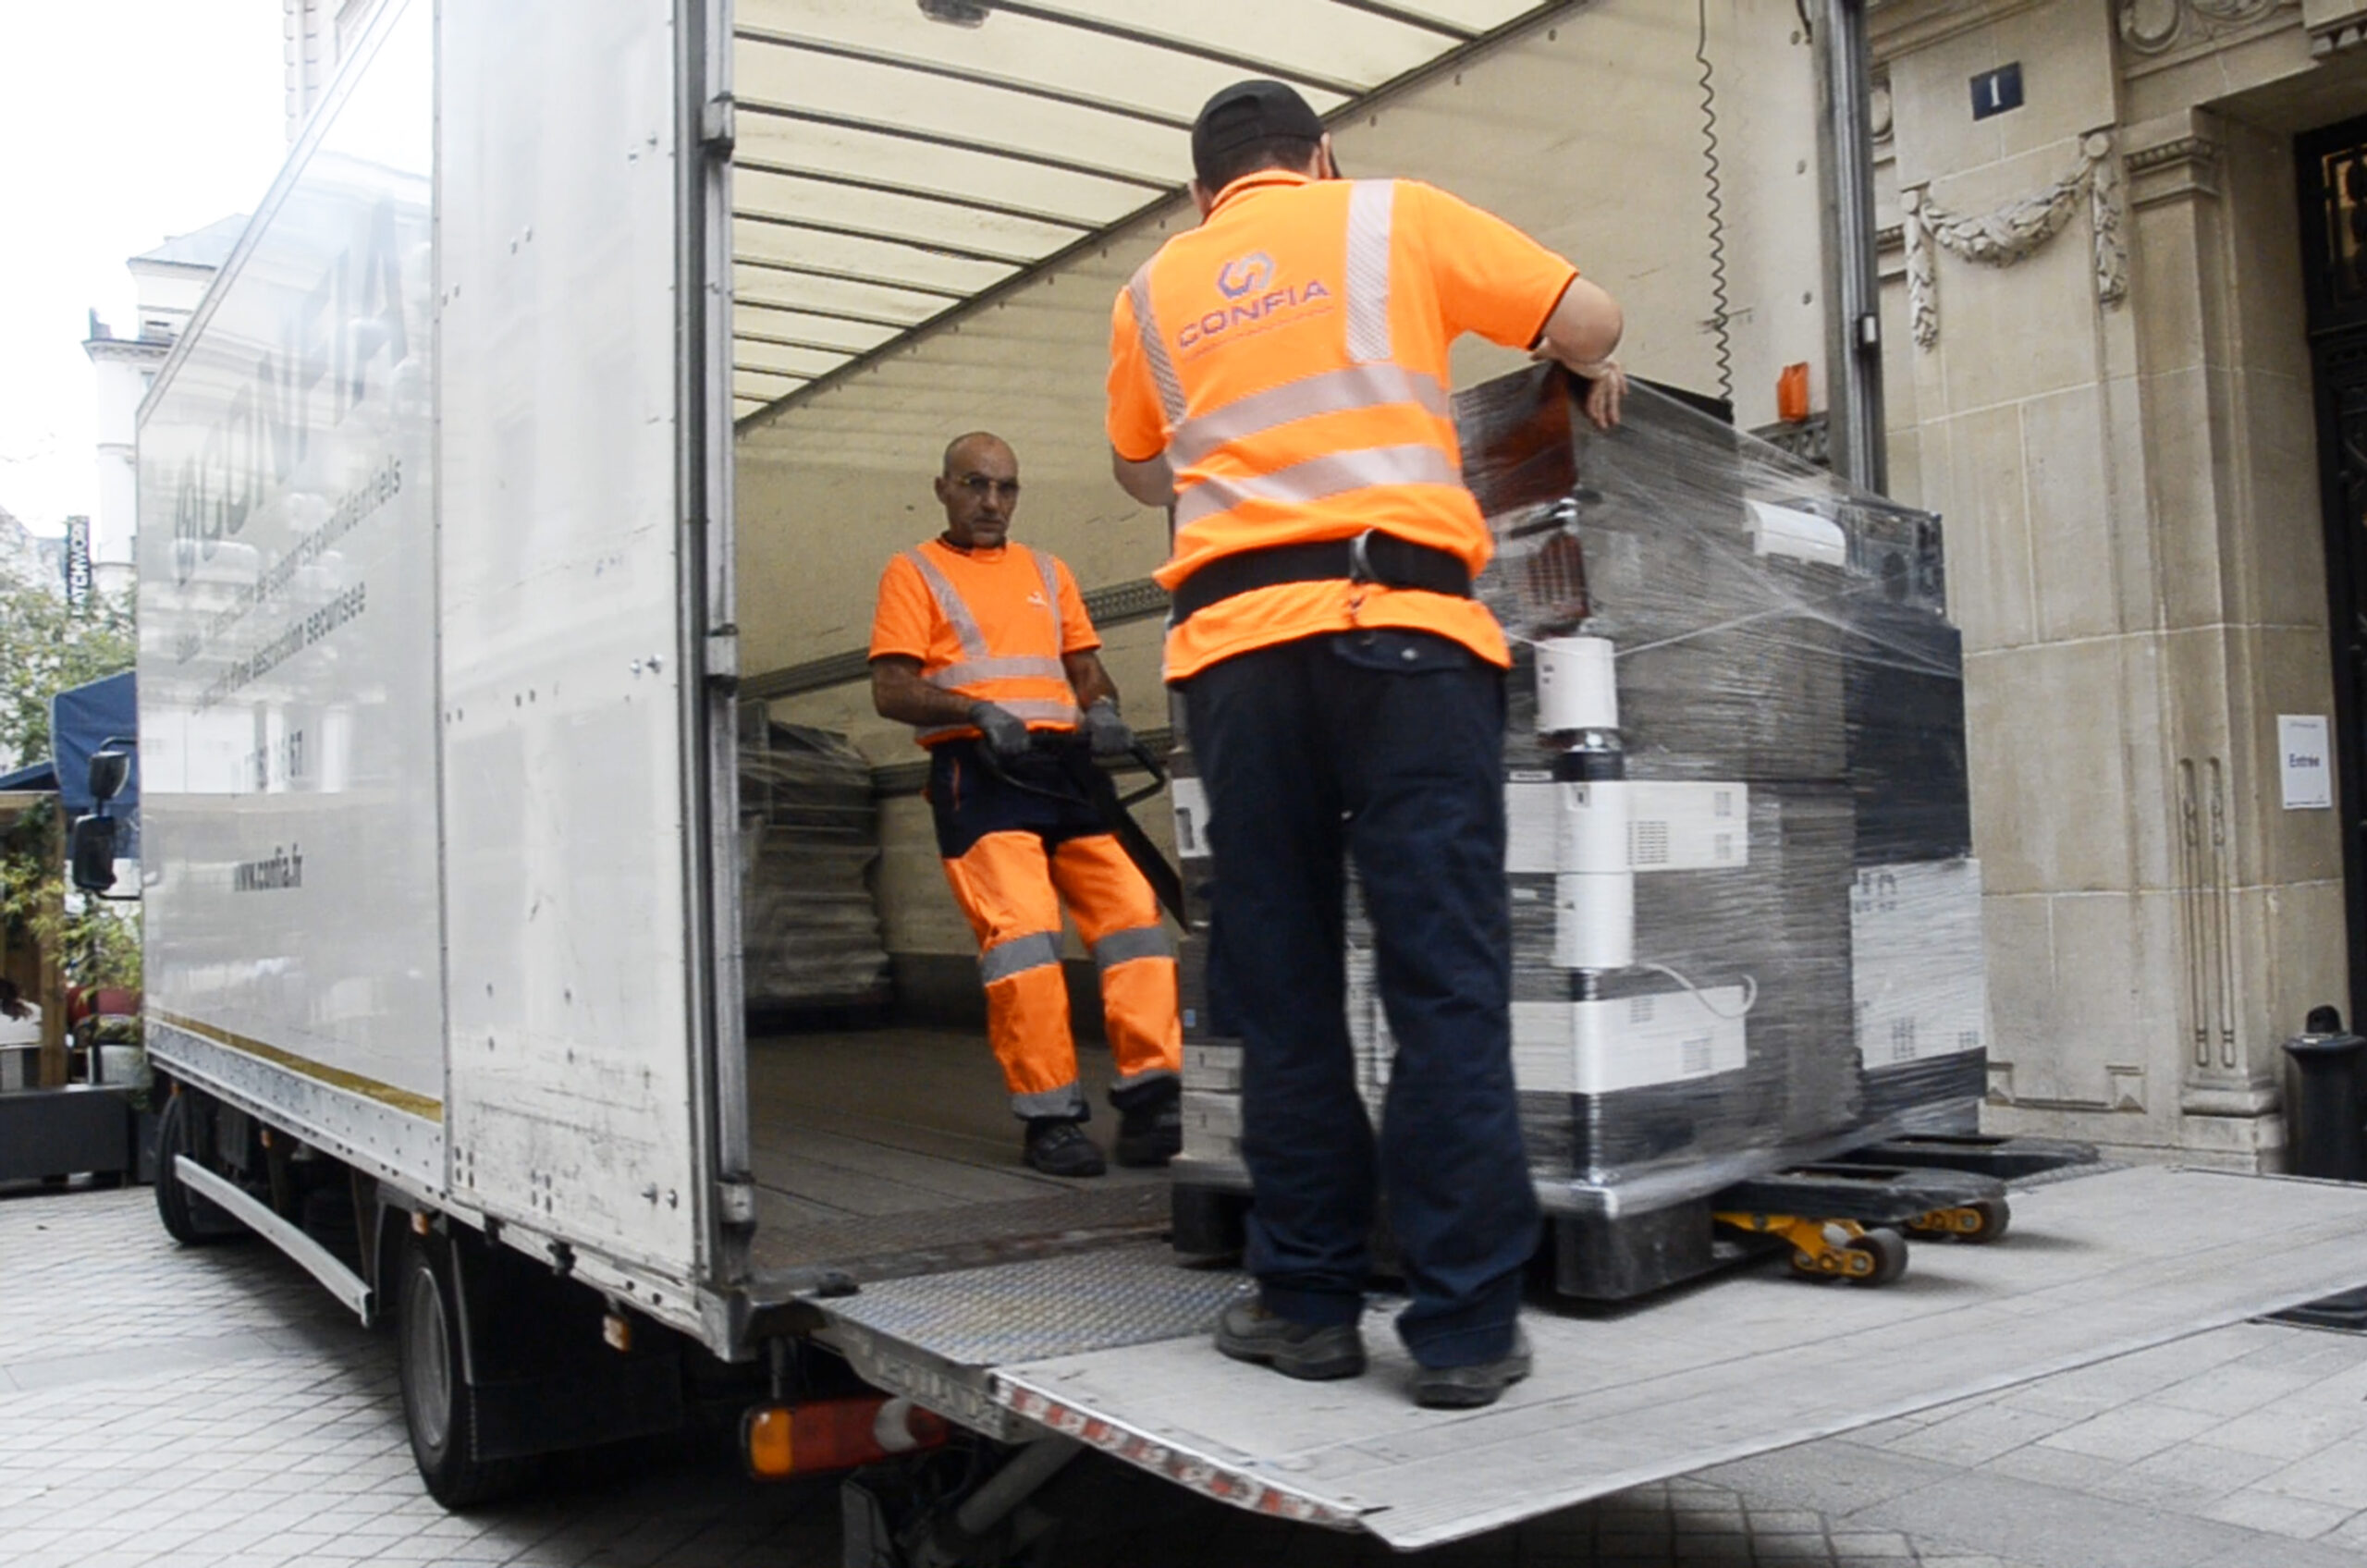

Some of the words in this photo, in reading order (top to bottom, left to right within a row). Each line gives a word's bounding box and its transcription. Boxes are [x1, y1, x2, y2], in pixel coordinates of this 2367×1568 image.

[1989, 75, 2001, 107] 1
[1179, 280, 1330, 348] CONFIA
[201, 192, 408, 561] CONFIA
